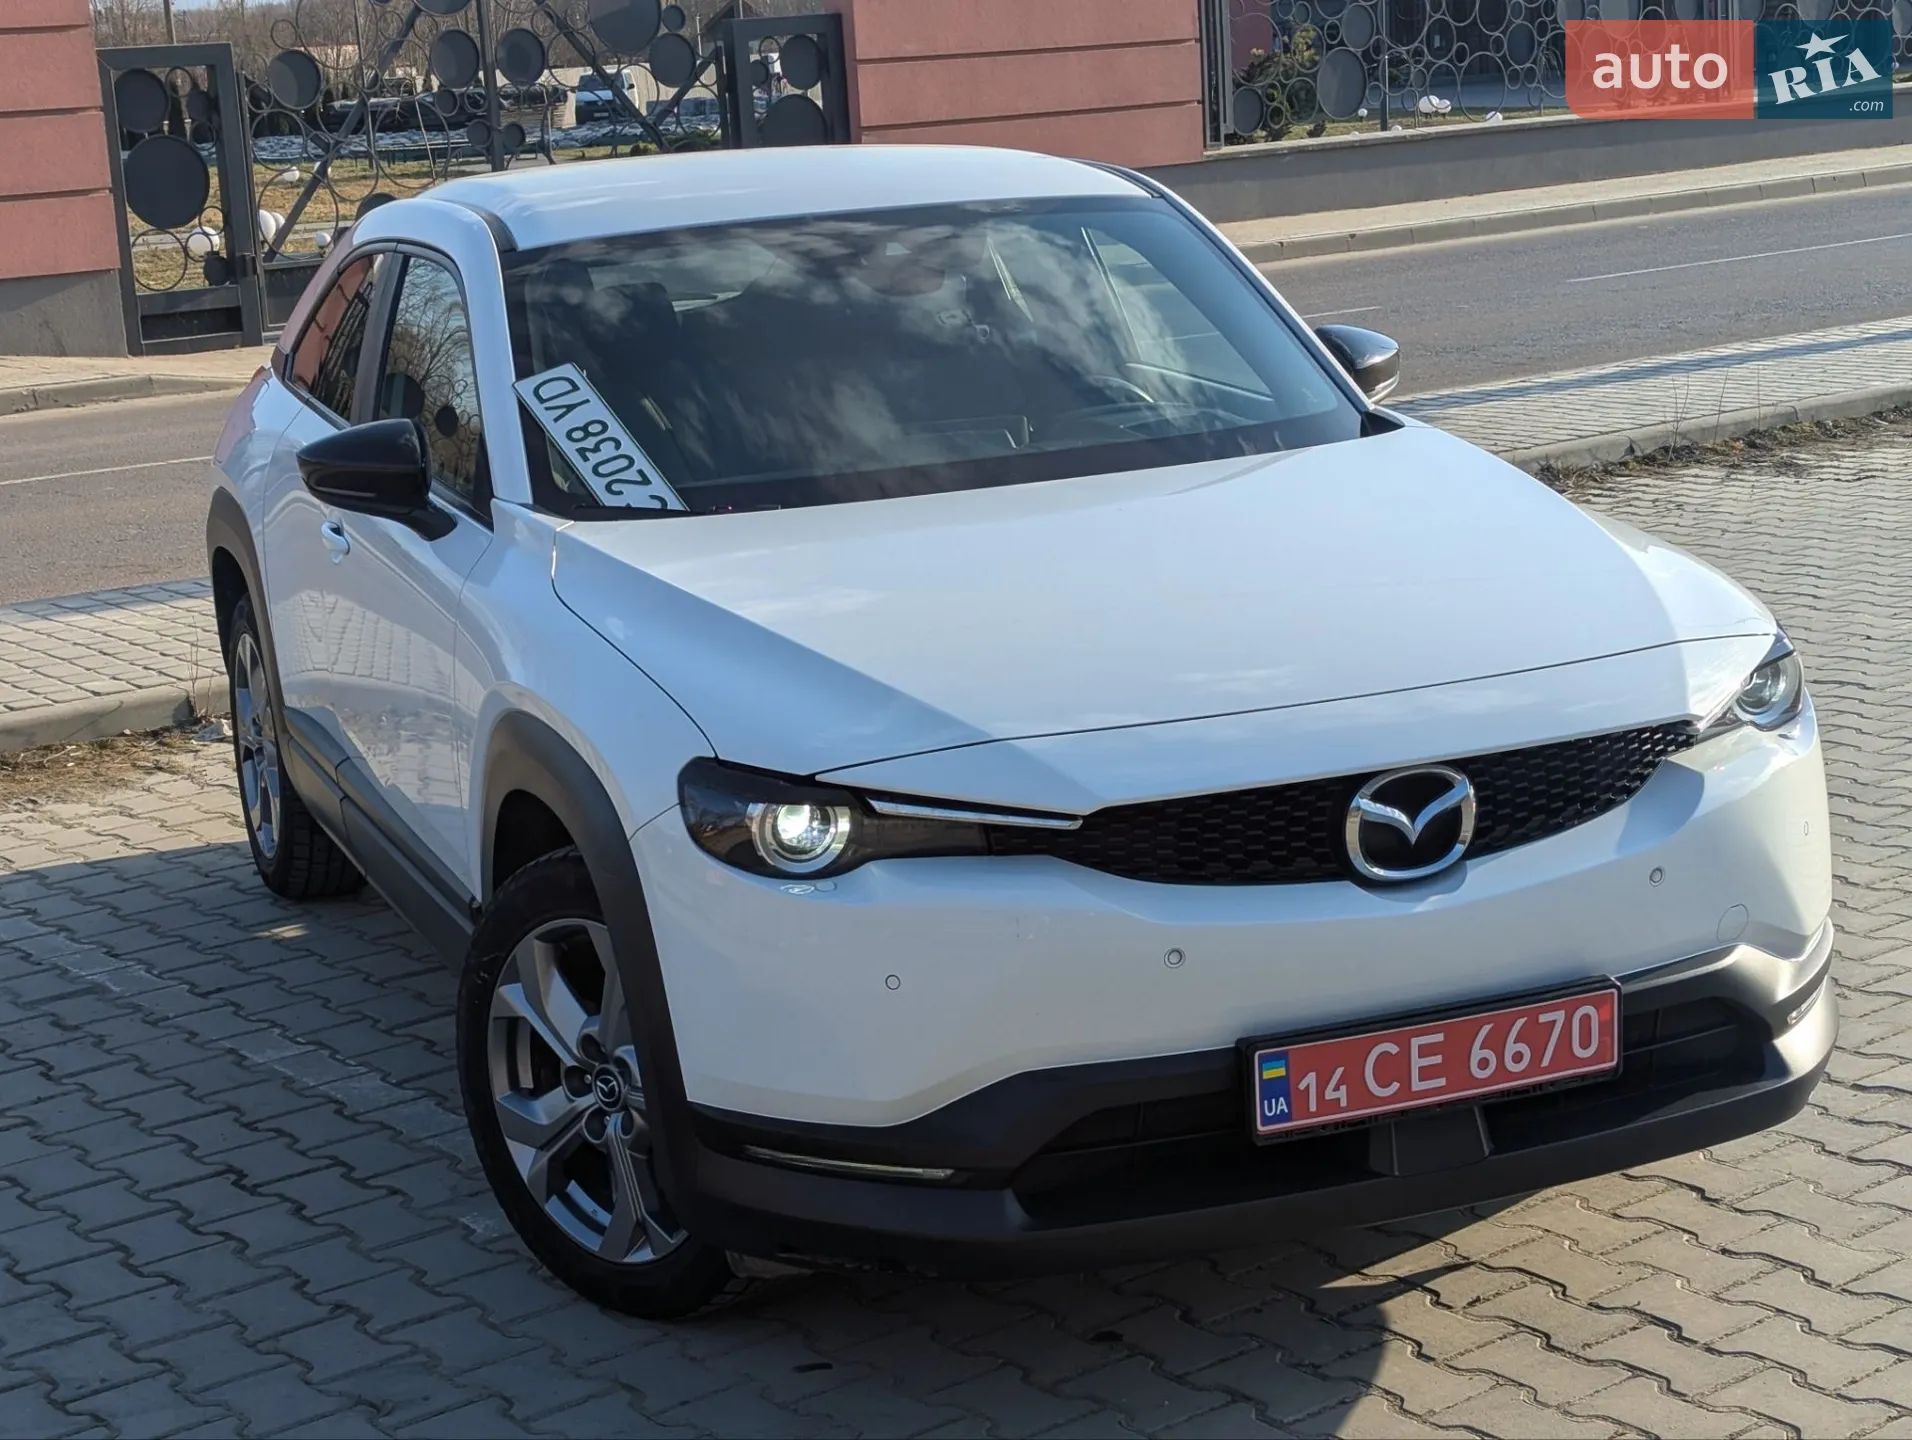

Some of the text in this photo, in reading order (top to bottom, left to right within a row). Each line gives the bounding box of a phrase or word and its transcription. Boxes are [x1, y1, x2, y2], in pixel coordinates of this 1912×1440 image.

[532, 376, 591, 423] YD
[565, 419, 653, 495] 2038
[1297, 1005, 1600, 1112] 14 CE 6670
[1264, 1097, 1288, 1116] UA
